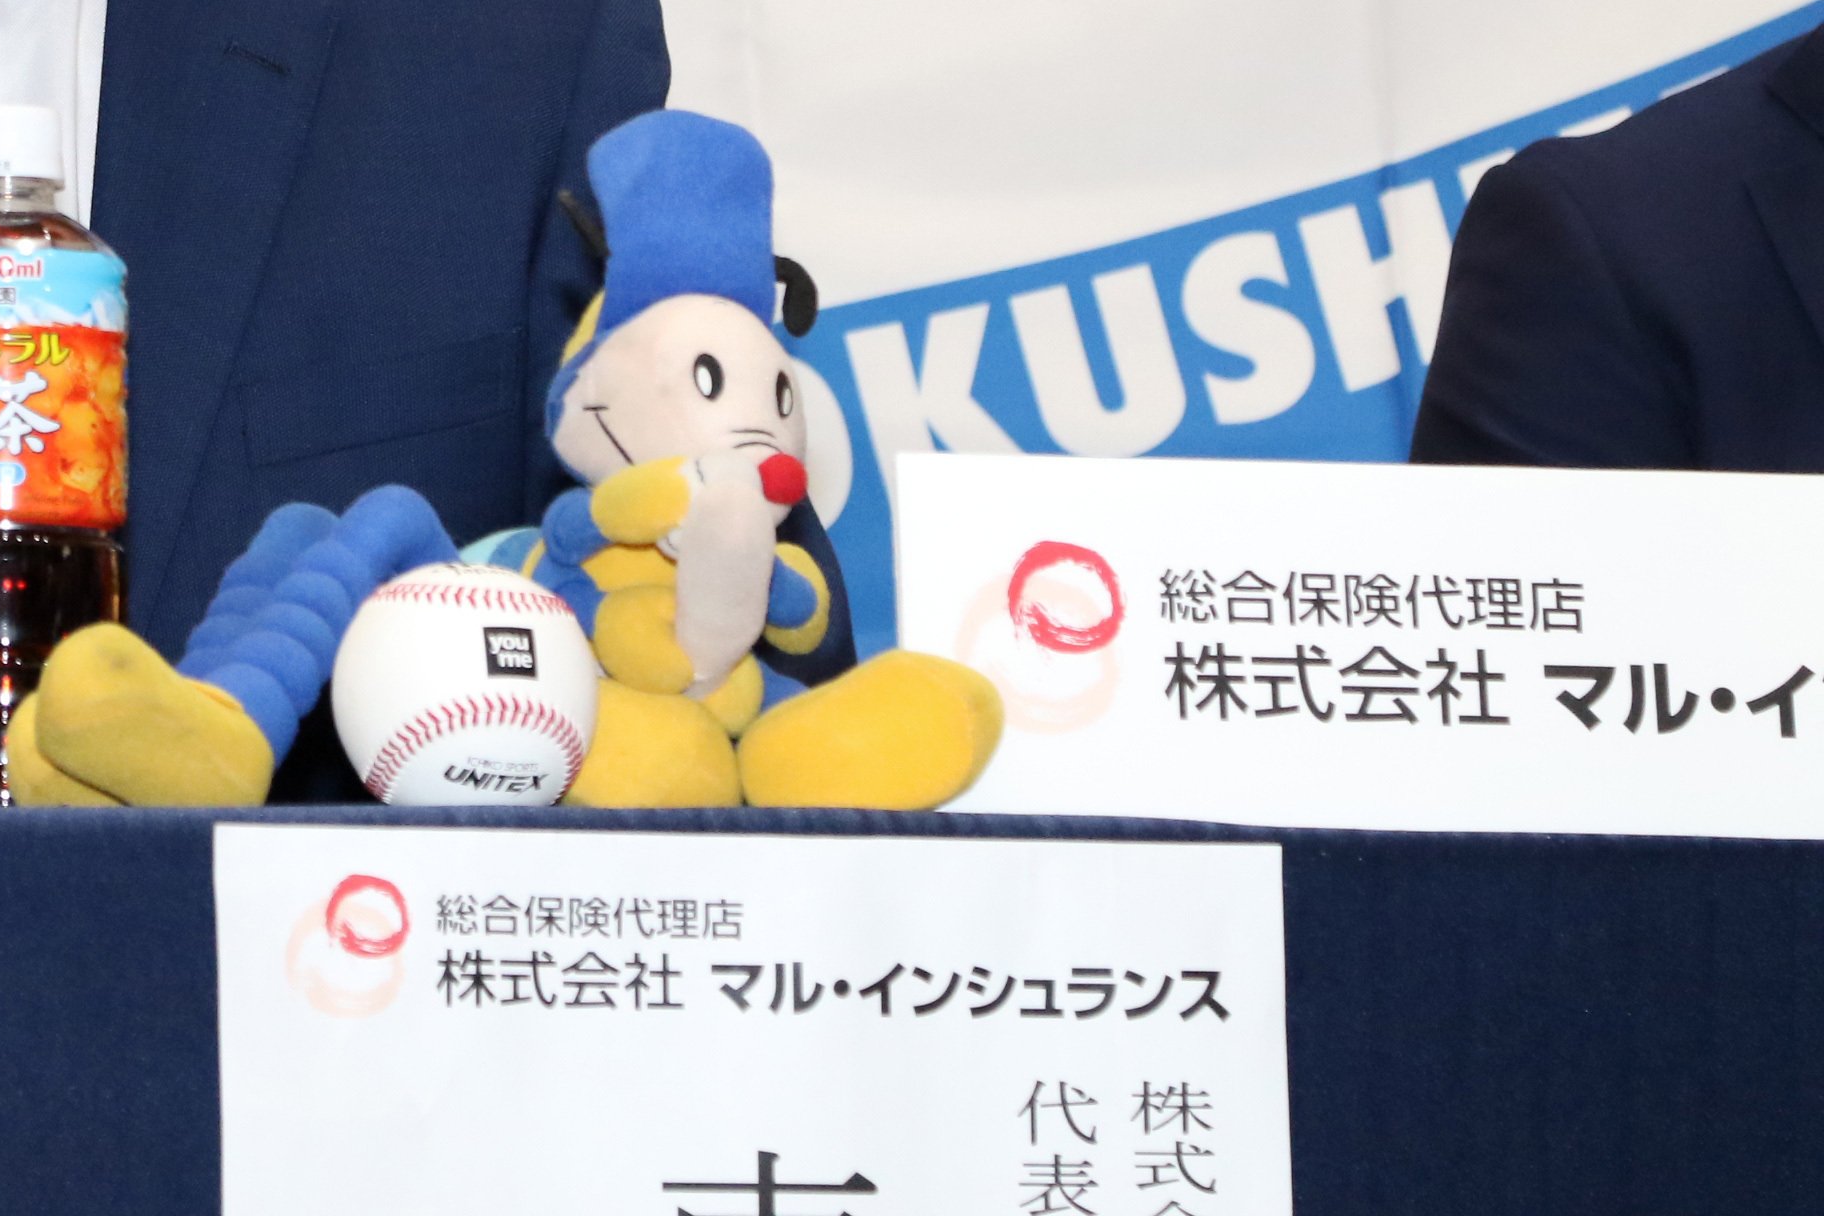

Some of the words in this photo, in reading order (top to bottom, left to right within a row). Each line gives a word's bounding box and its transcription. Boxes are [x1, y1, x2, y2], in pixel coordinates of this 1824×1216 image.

[1160, 568, 1585, 632] 総合保険代理店
[488, 633, 530, 654] you
[497, 652, 534, 669] me
[1164, 641, 1511, 727] 株式会社
[1543, 663, 1824, 739] マル・イ
[443, 765, 551, 796] UNITEX
[435, 894, 745, 940] 総合保険代理店
[436, 949, 684, 1010] 株式会社
[710, 962, 1231, 1021] マル・インシュランス
[1130, 1081, 1217, 1216] 株式
